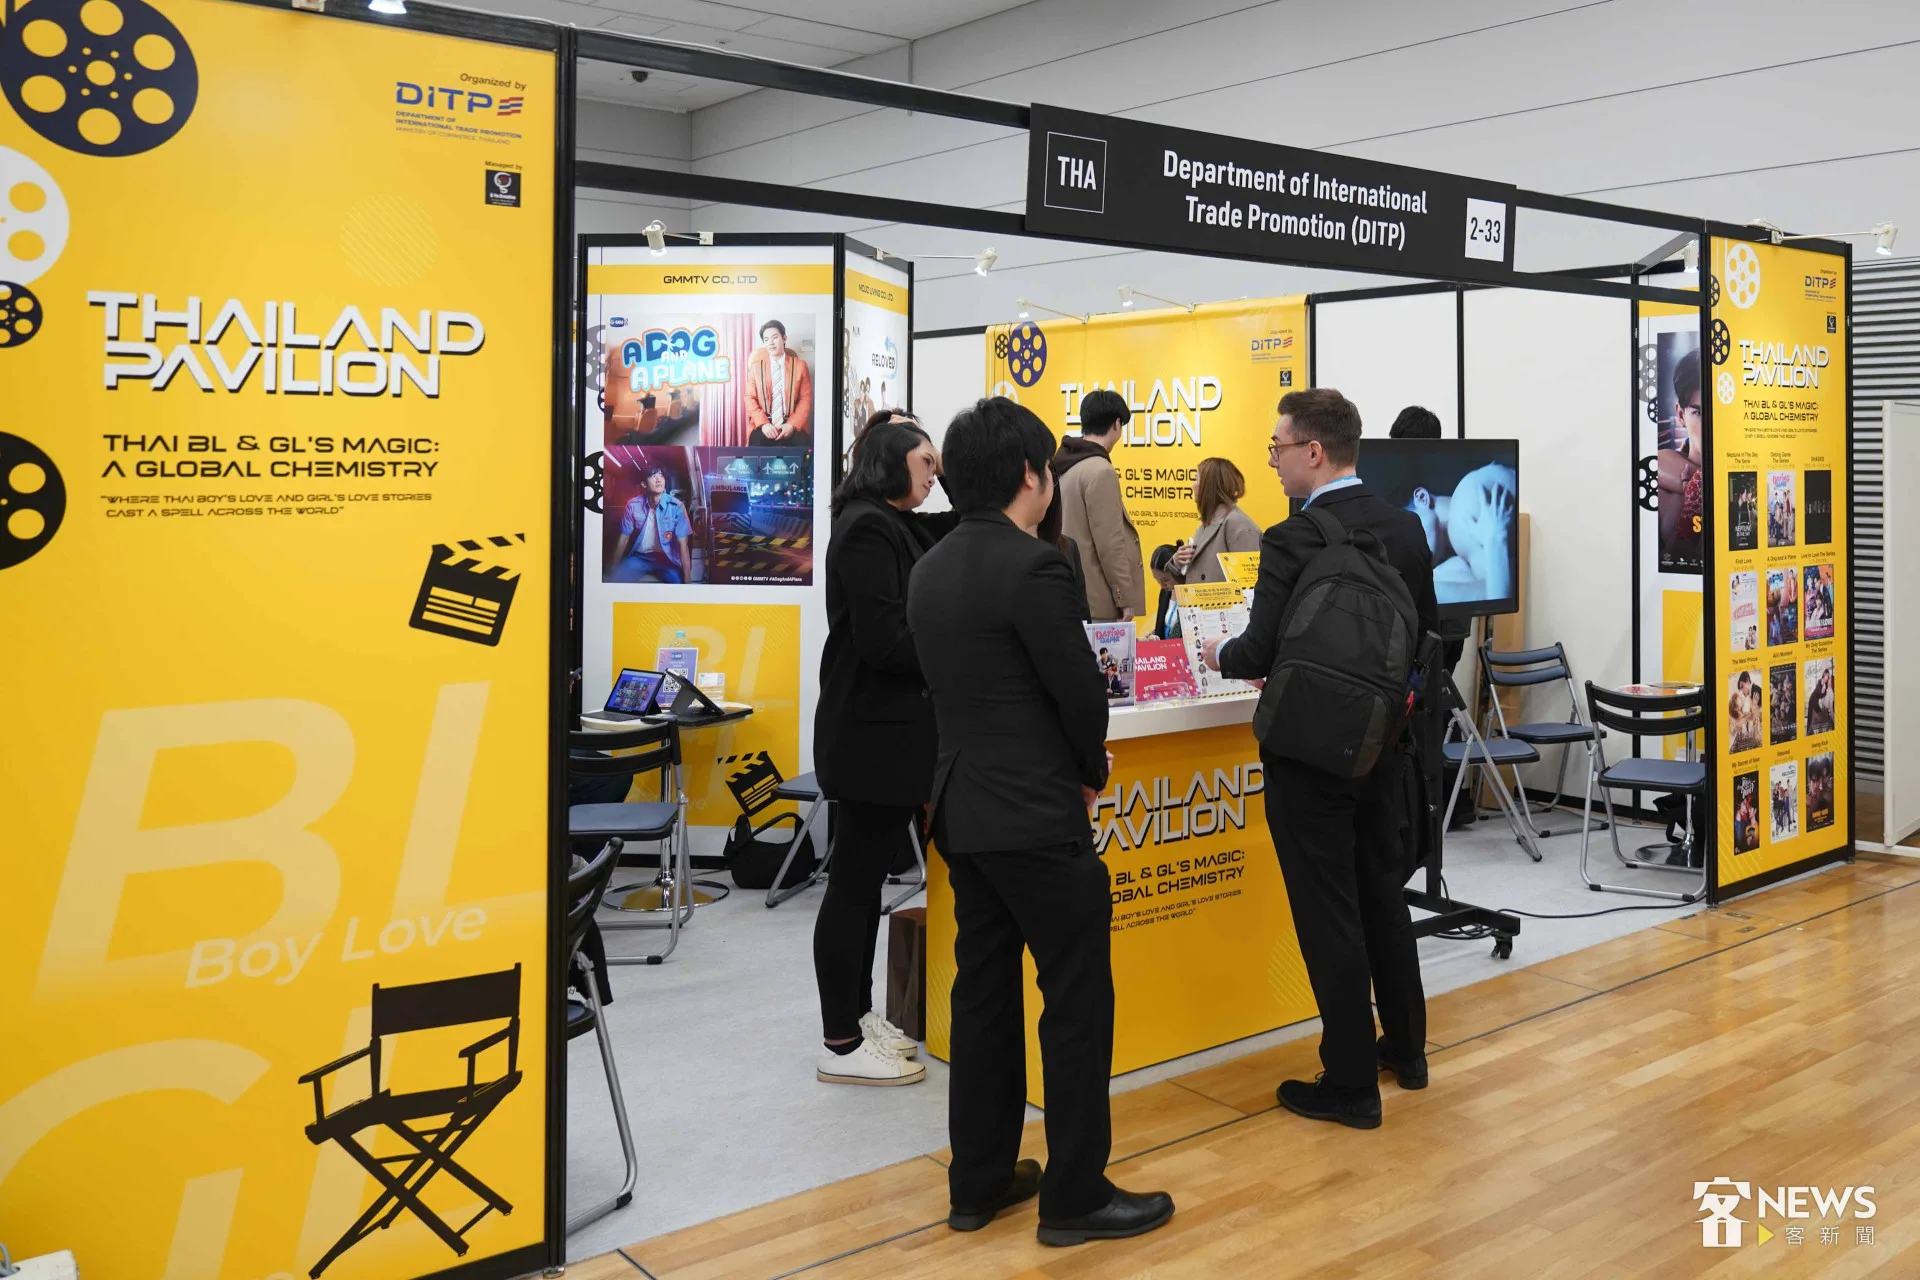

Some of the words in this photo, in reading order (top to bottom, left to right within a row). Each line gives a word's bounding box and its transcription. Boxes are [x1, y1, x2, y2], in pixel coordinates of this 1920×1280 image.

[460, 73, 512, 88] Organized
[514, 80, 527, 91] by
[396, 111, 444, 122] DEPARTMENT
[396, 118, 453, 131] INTERNATIONAL
[1057, 155, 1097, 191] THA
[1163, 149, 1285, 194] Department
[1289, 172, 1310, 196] of
[1313, 174, 1428, 214] International
[1185, 195, 1242, 228] Trade
[1247, 204, 1345, 241] Promotion
[1350, 215, 1406, 252] (DITP)
[1470, 216, 1502, 244] 2-33
[663, 275, 710, 284] GMMTV
[737, 275, 758, 284] LTD
[87, 291, 485, 356] THAILAND
[623, 341, 642, 366] A
[645, 329, 717, 362] DOG
[661, 350, 688, 363] AND
[1739, 340, 1829, 368] THAILAND
[104, 341, 440, 398] PAVILION
[631, 366, 649, 391] A
[652, 357, 730, 389] PLANE
[1743, 363, 1819, 389] PAVILION
[1743, 412, 1749, 420] A
[1750, 412, 1778, 421] GLOBAL
[1779, 412, 1819, 422] CHEMISTRY
[1744, 400, 1759, 409] THAI
[1761, 400, 1770, 409] BL
[1771, 401, 1777, 409] &
[1779, 401, 1795, 410] GL'S
[1795, 402, 1819, 411] MAGIC:
[103, 434, 178, 452] THAI
[188, 435, 227, 452] BL
[236, 435, 260, 451] &
[269, 436, 335, 453] GL'S
[343, 437, 440, 454] MAGIC:
[101, 460, 127, 478] A
[136, 460, 261, 478] GLOBAL
[270, 460, 439, 478] CHEMISTRY
[1125, 468, 1153, 481] GL'S
[163, 495, 194, 504] THAI
[196, 494, 236, 503] BOY'S
[239, 494, 273, 503] LOVE
[276, 494, 304, 503] AND
[306, 493, 345, 503] GIRL'S
[348, 493, 379, 502] LOVE
[382, 493, 433, 502] STORIES
[1125, 486, 1193, 500] CHEMISTR
[106, 509, 144, 518] CAST
[147, 509, 158, 517] A
[161, 508, 204, 517] SPELL
[207, 507, 263, 516] ACROSS
[267, 507, 293, 516] THE
[295, 506, 344, 516] WORLD"
[1095, 628, 1126, 640] DATING
[1092, 762, 1265, 822] HAILAND
[32, 681, 546, 1000] BL
[1115, 871, 1136, 886] BL
[1140, 867, 1153, 880] &
[1156, 860, 1190, 877] GL'S
[1194, 850, 1246, 870] MAGIC:
[1111, 885, 1153, 904] OBAL
[1157, 865, 1245, 895] CHEMISTRY
[1120, 910, 1141, 921] BOY'S
[1141, 907, 1159, 918] LOVE
[1160, 903, 1175, 913] AND
[1176, 899, 1197, 910] GIRL'S
[1197, 895, 1214, 905] LOVE
[1126, 918, 1155, 929] ACROSS
[1155, 915, 1170, 924] THE
[185, 930, 323, 989] Boy
[341, 906, 488, 962] Love
